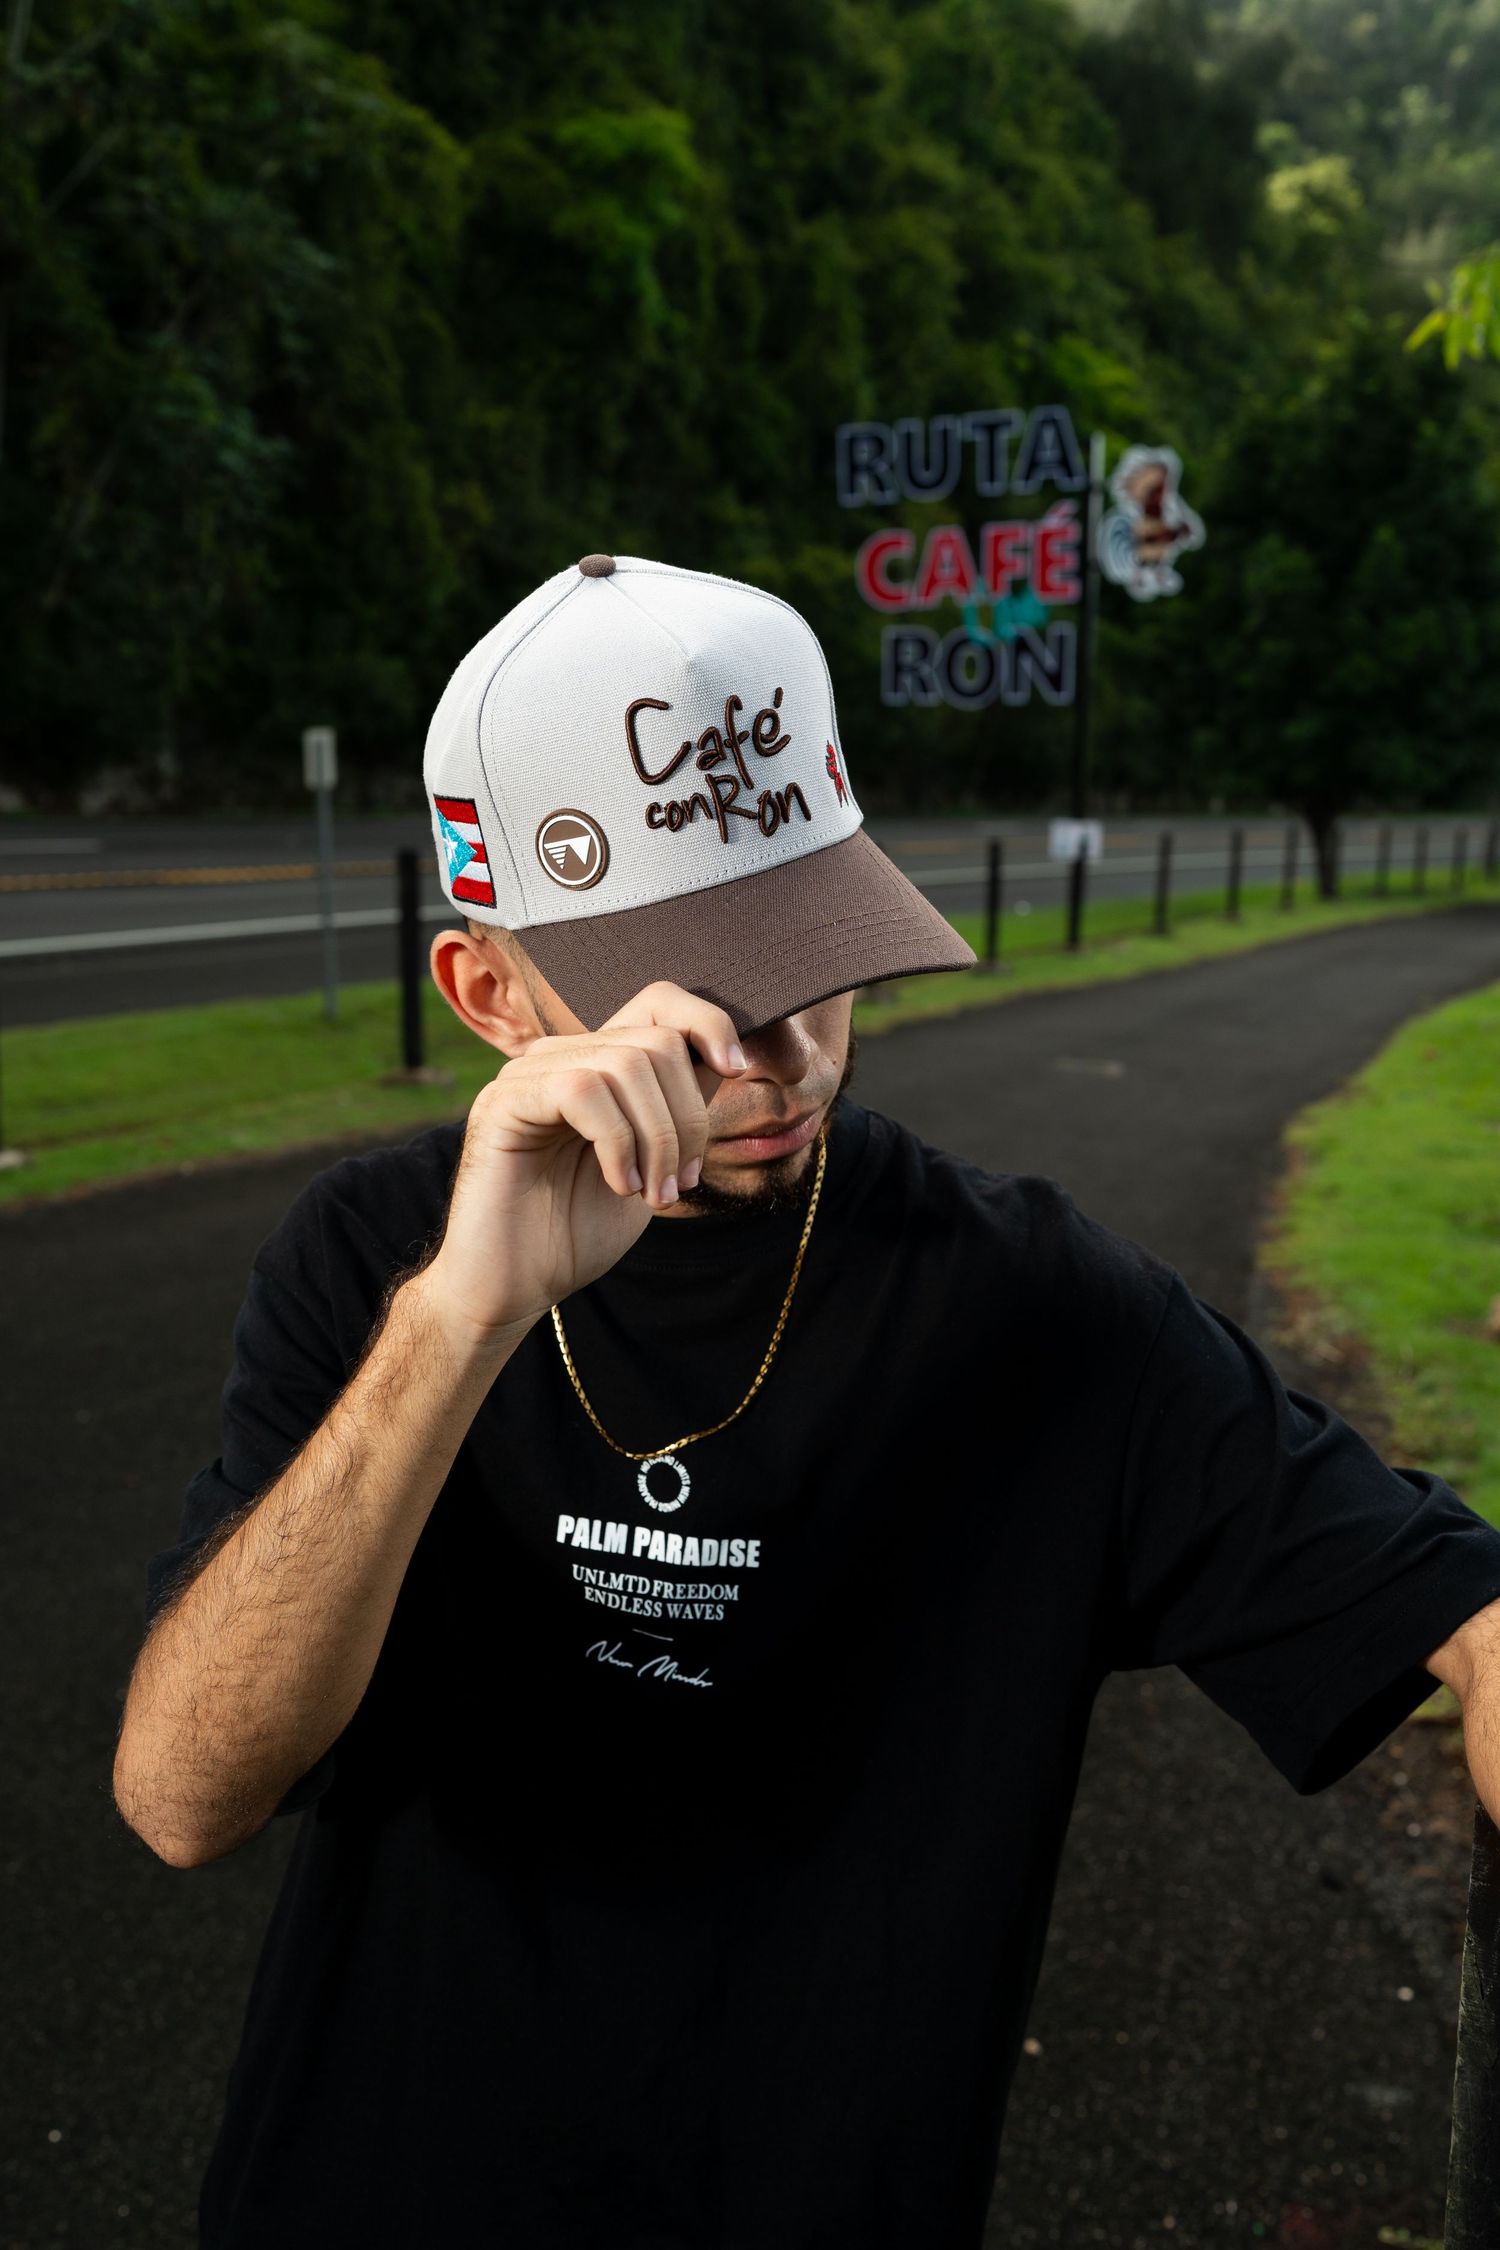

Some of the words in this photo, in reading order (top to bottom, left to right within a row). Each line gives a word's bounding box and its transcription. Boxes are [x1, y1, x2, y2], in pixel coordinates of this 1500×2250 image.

[835, 404, 1088, 508] RUTA
[855, 500, 1083, 613] CAFÉ
[881, 620, 1077, 711] RON
[624, 686, 792, 790] Café
[556, 1514, 629, 1555] PALM
[632, 1526, 761, 1568] PARADISE
[572, 1564, 651, 1595] UNLMTD
[651, 1580, 739, 1601] FREEDOM
[584, 1586, 663, 1618] ENDLESS
[666, 1603, 725, 1621] WAVES
